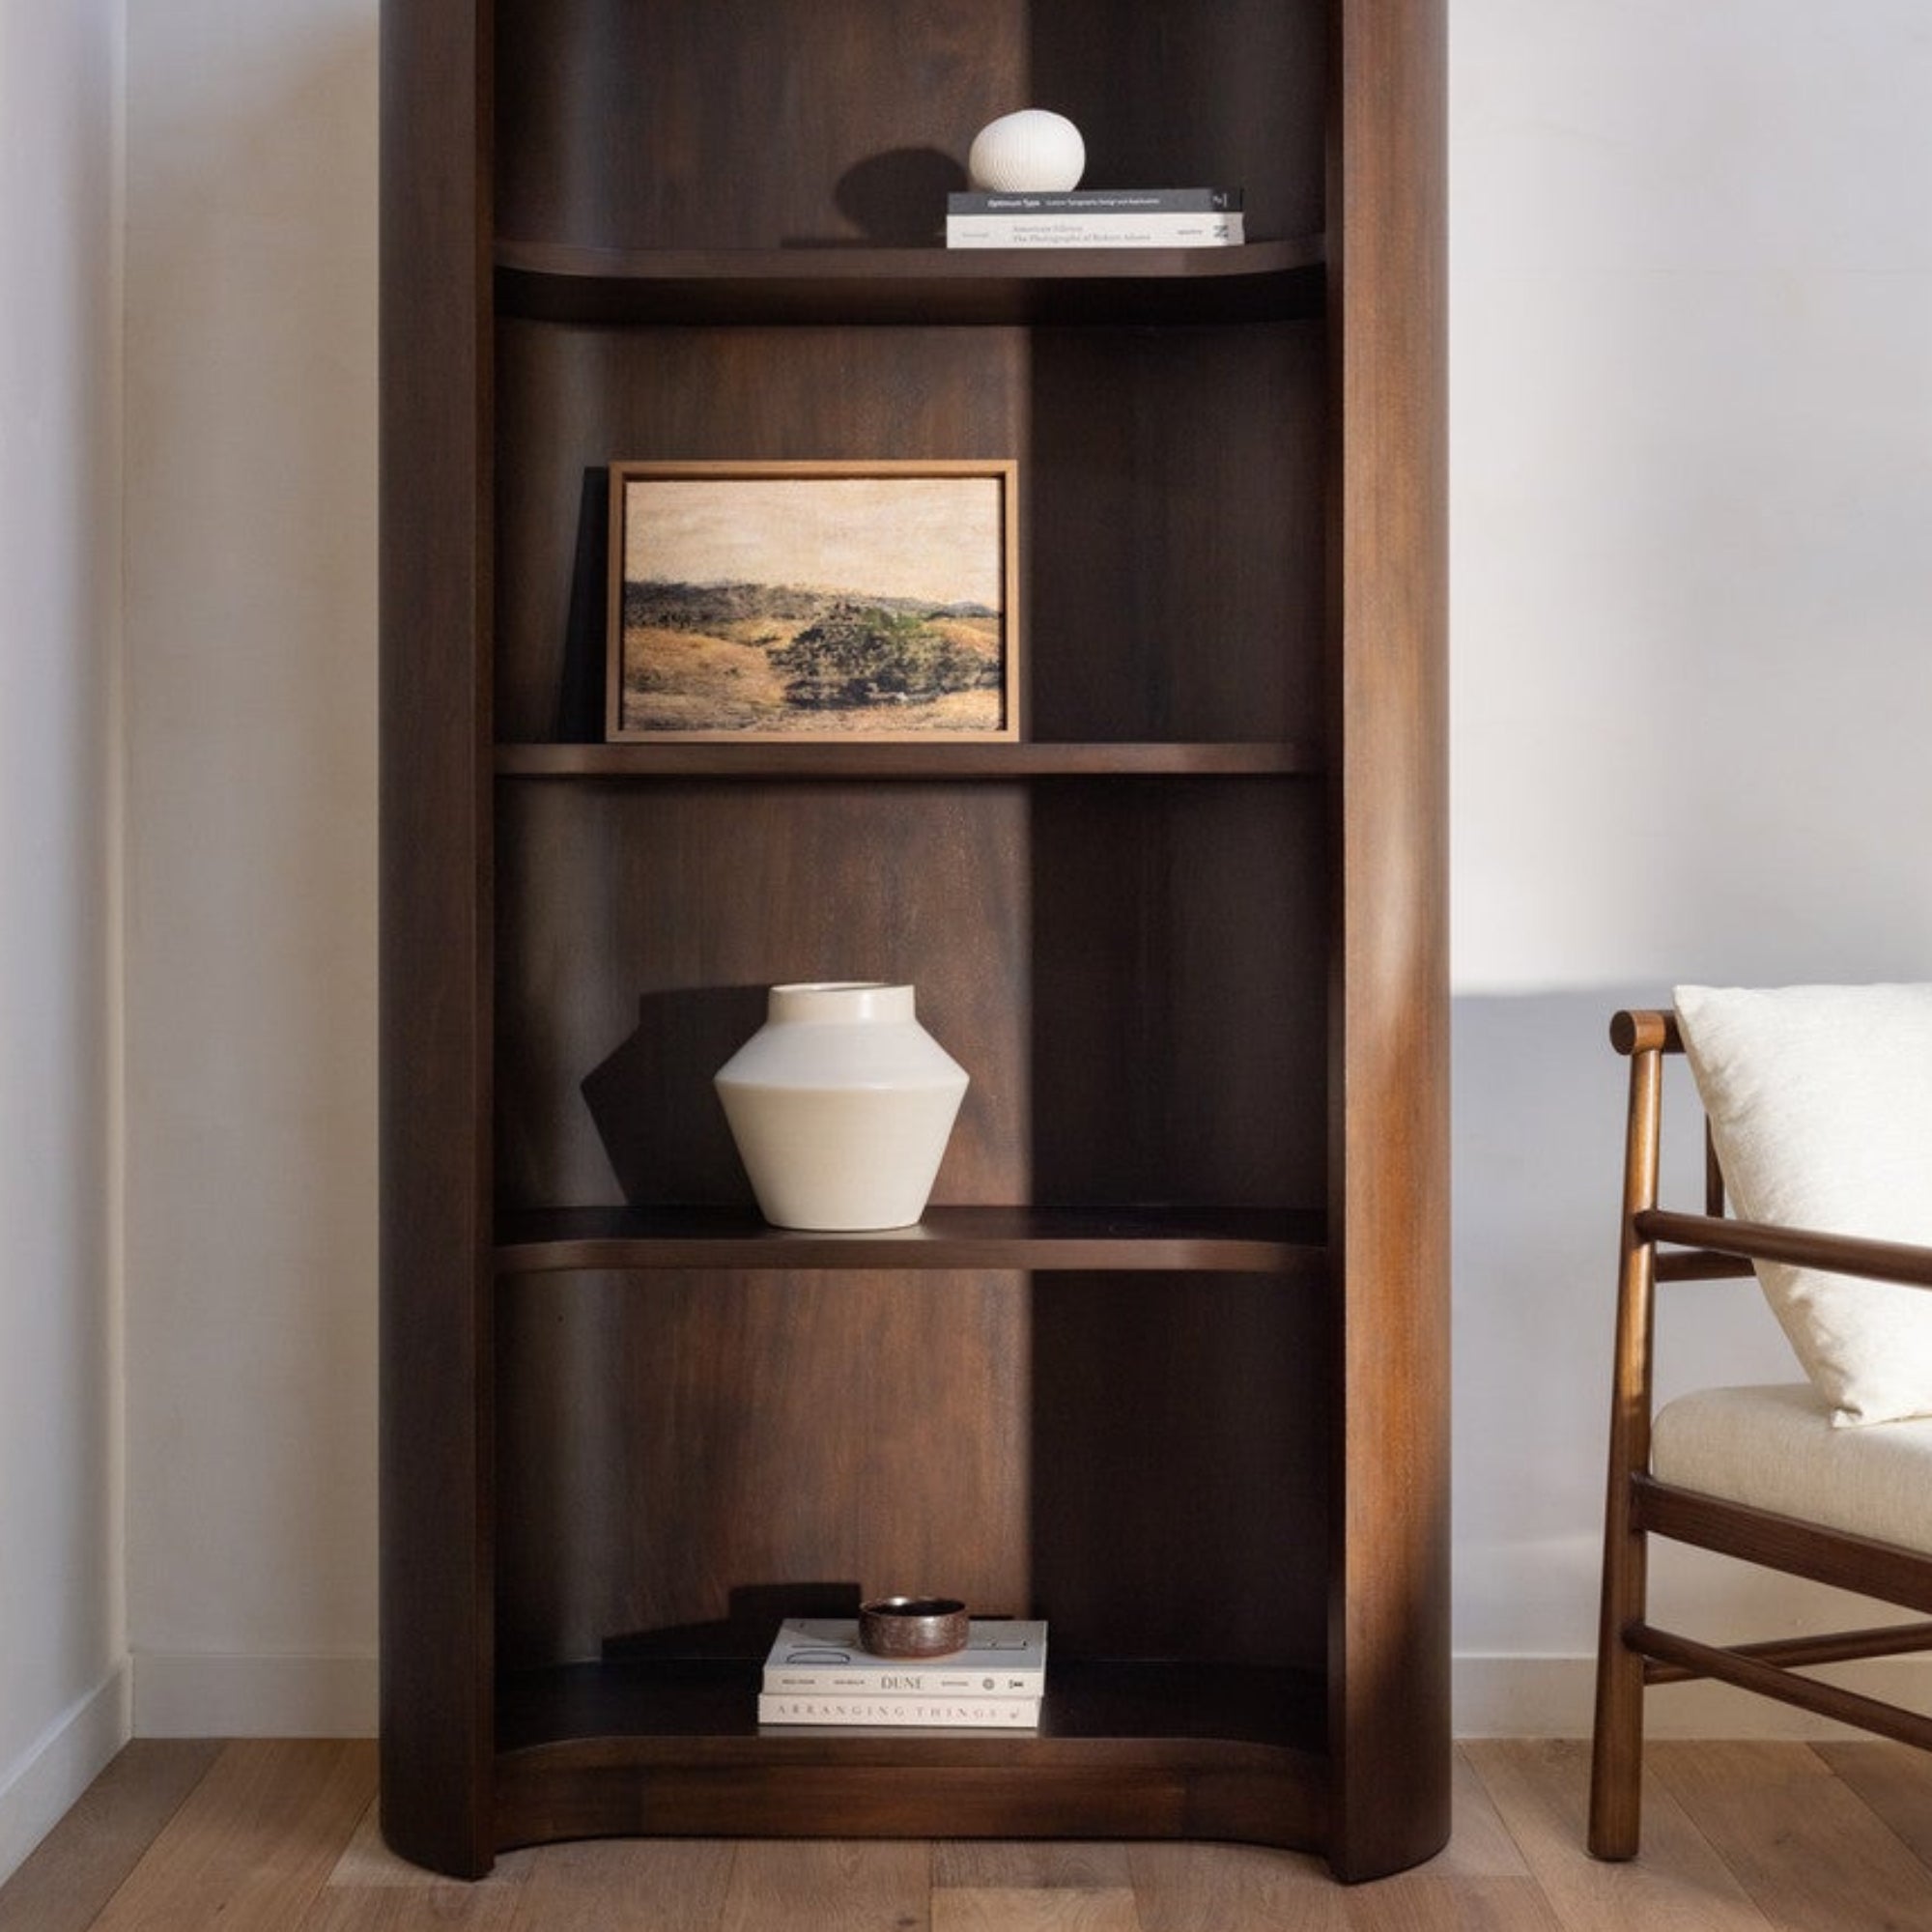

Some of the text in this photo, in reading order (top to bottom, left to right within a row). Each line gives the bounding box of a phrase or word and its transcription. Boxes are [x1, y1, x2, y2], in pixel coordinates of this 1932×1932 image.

[881, 1676, 922, 1689] DUNE
[779, 1704, 997, 1718] ARRANGING THINGS
